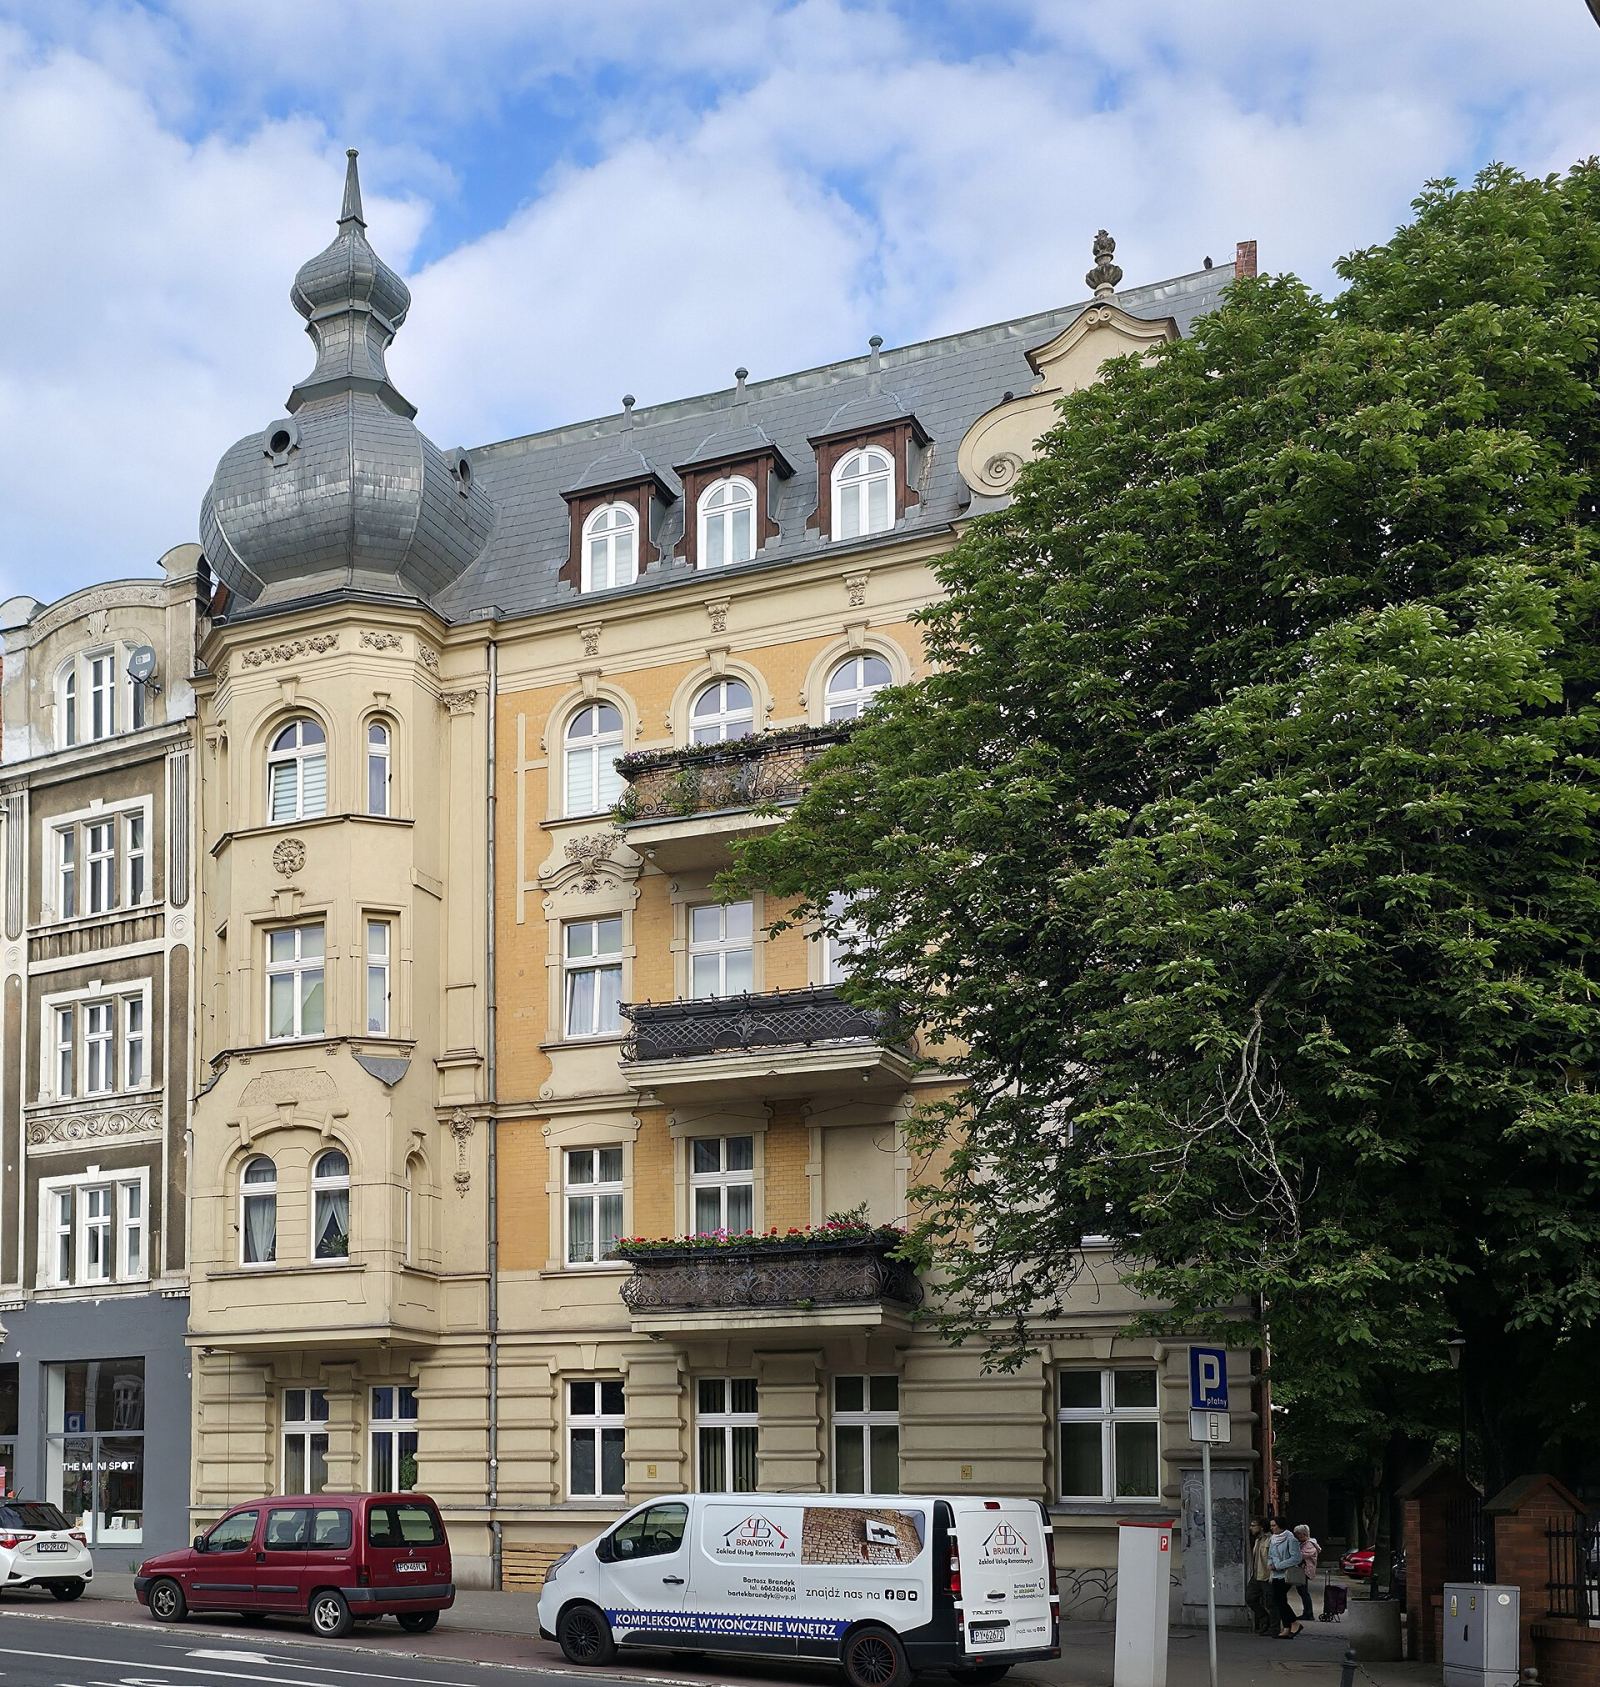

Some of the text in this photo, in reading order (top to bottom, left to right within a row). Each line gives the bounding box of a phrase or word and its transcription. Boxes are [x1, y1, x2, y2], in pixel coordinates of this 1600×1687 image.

[1199, 1354, 1220, 1401] P
[62, 1462, 80, 1471] THE
[736, 1539, 774, 1548] BRANDYK
[1161, 1537, 1167, 1549] P
[755, 1549, 796, 1558] Remontowych
[768, 1578, 795, 1586] Brandyk
[760, 1585, 796, 1593] 606268404
[843, 1590, 863, 1599] nas
[867, 1591, 880, 1600] na
[615, 1614, 836, 1636] KOMPLEKSOWE WYKOŃCZENIE WNĘTRZ
